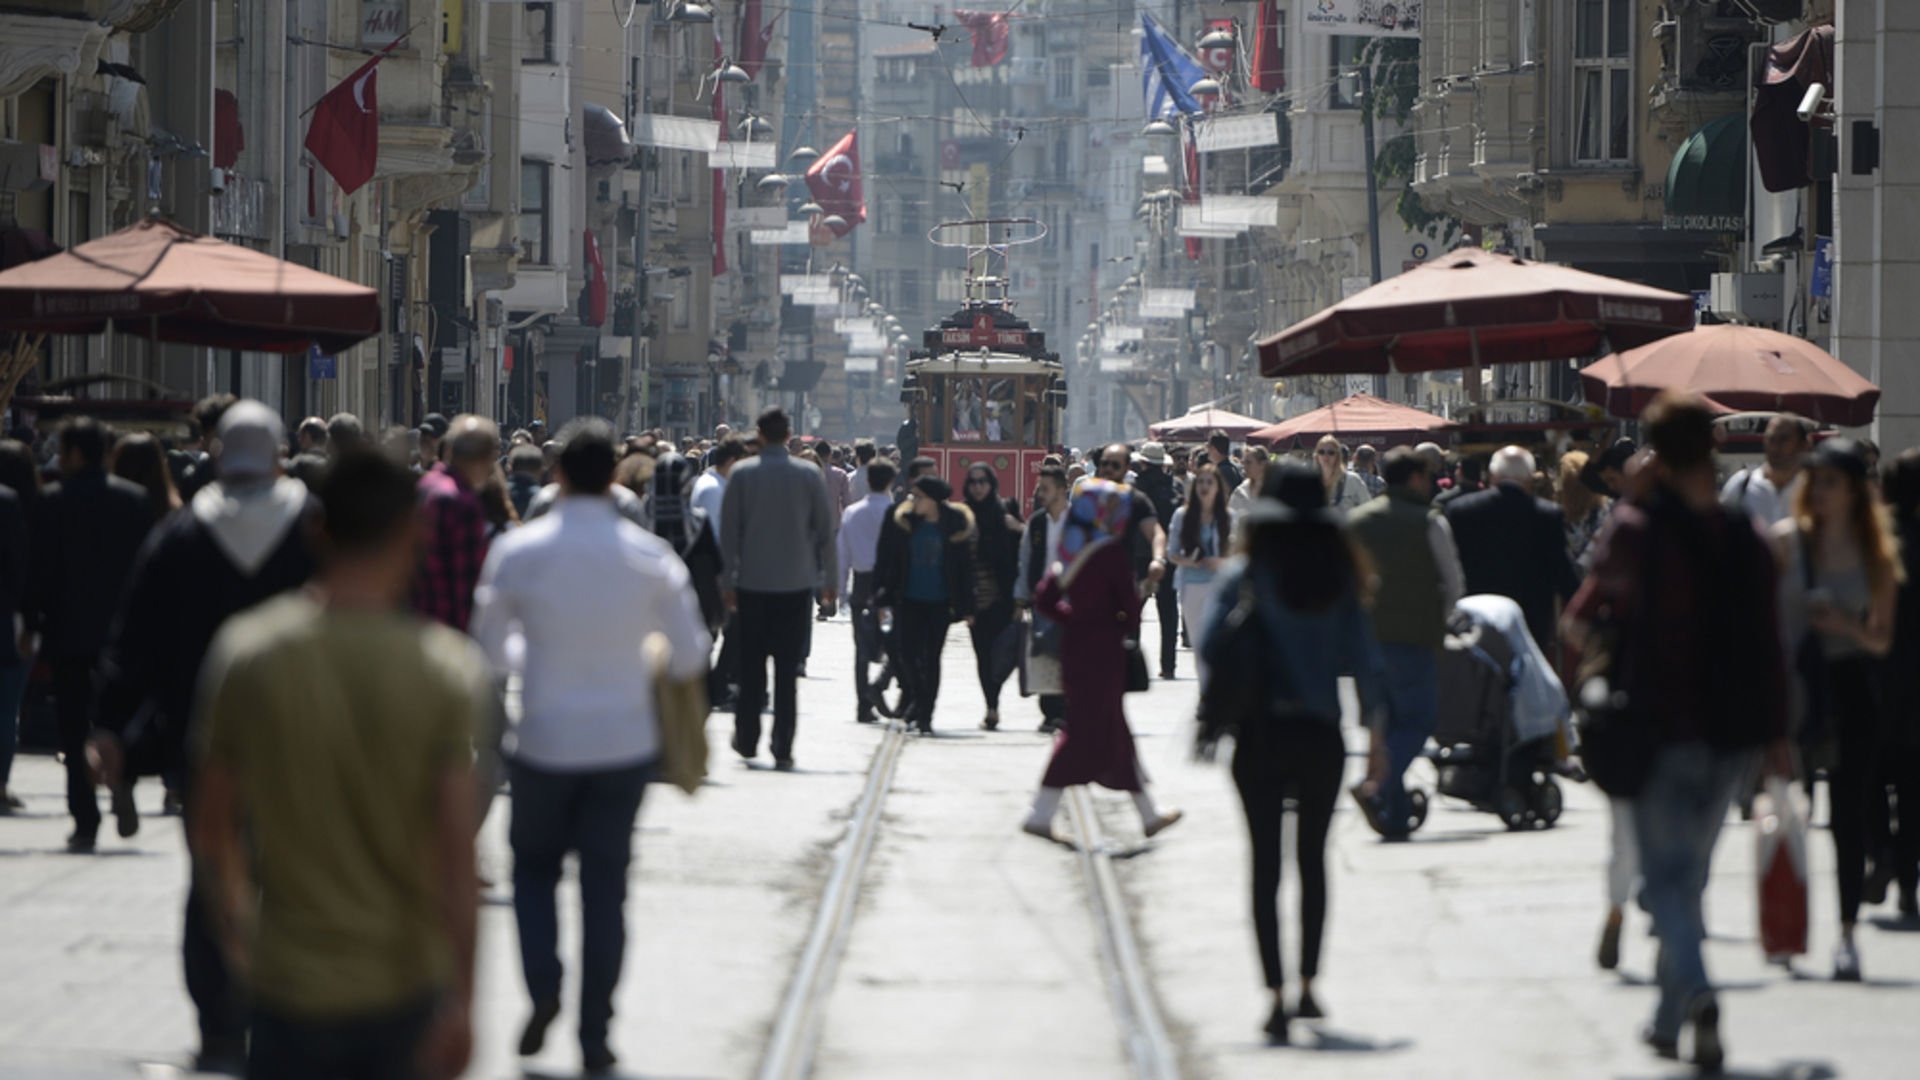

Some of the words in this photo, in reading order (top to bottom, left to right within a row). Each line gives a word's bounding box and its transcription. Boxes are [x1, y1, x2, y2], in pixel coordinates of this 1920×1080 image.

[365, 9, 402, 34] H&M
[978, 316, 986, 329] 4
[1350, 380, 1369, 390] WC
